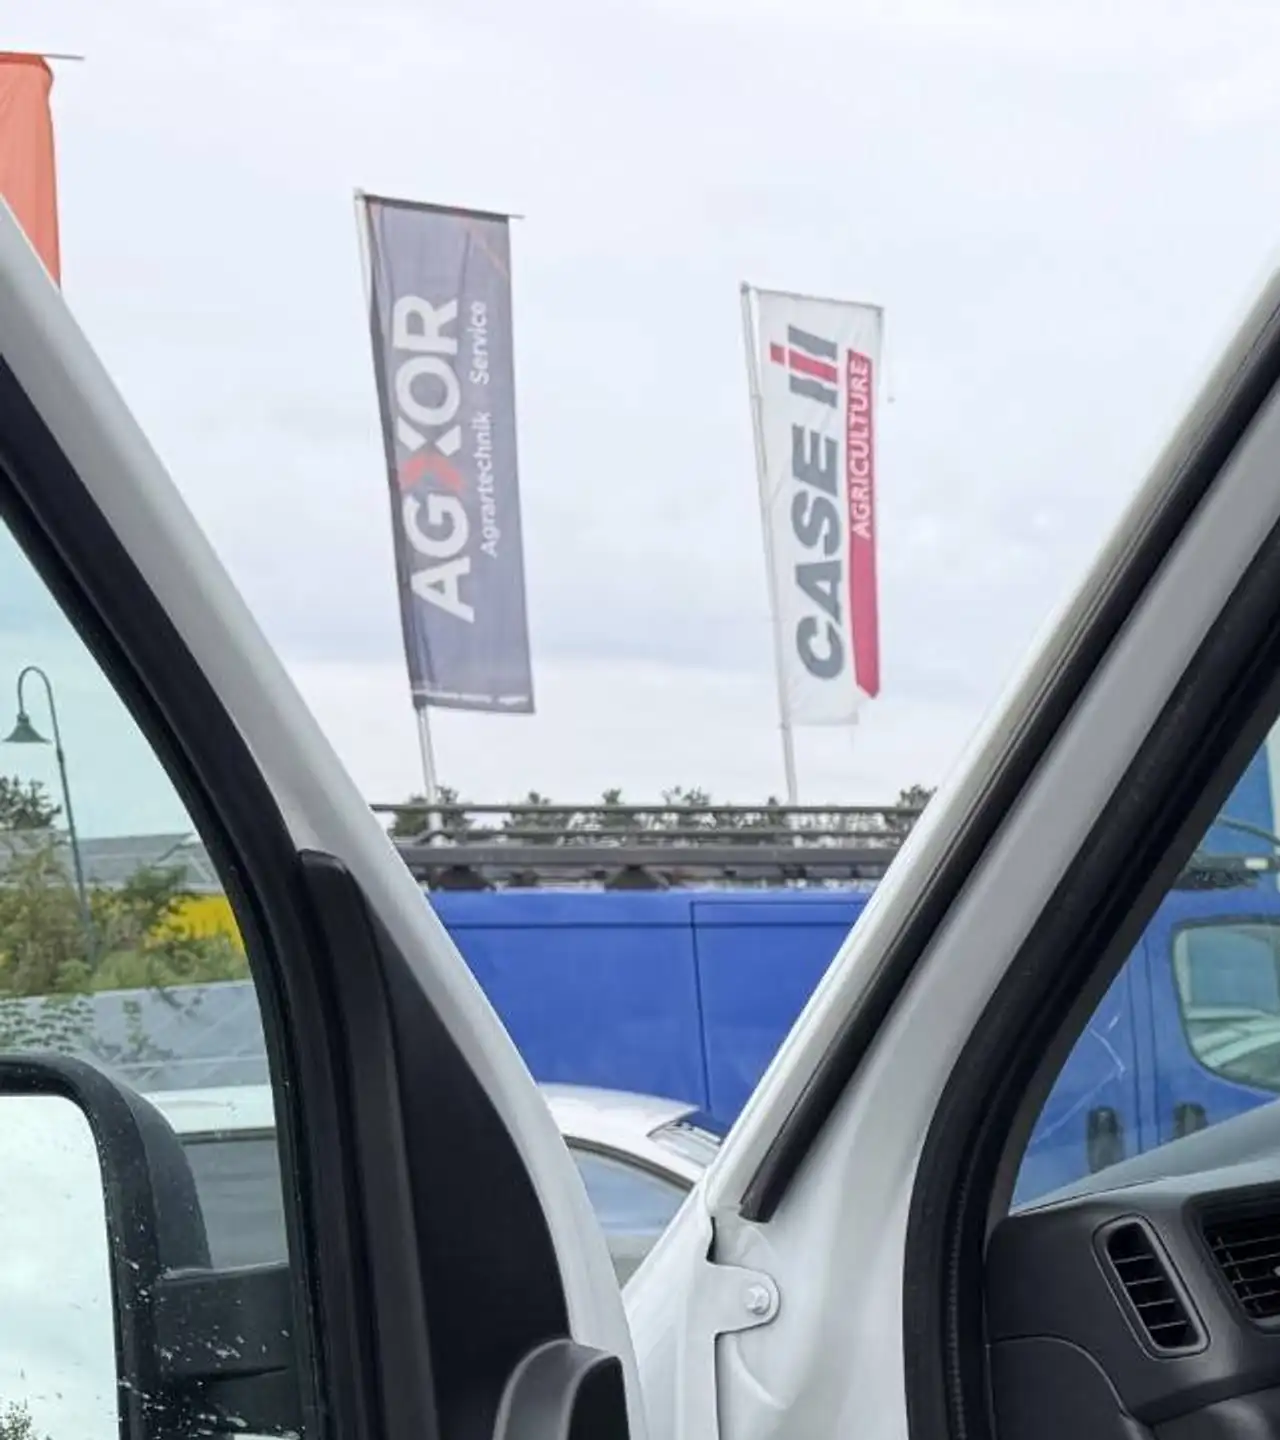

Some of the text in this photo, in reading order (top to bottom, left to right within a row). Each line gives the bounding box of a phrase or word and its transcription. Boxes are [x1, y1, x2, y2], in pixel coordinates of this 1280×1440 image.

[468, 300, 497, 558] Agrartechnik Service
[792, 424, 845, 680] CASE
[849, 358, 872, 539] AGRICULTURE
